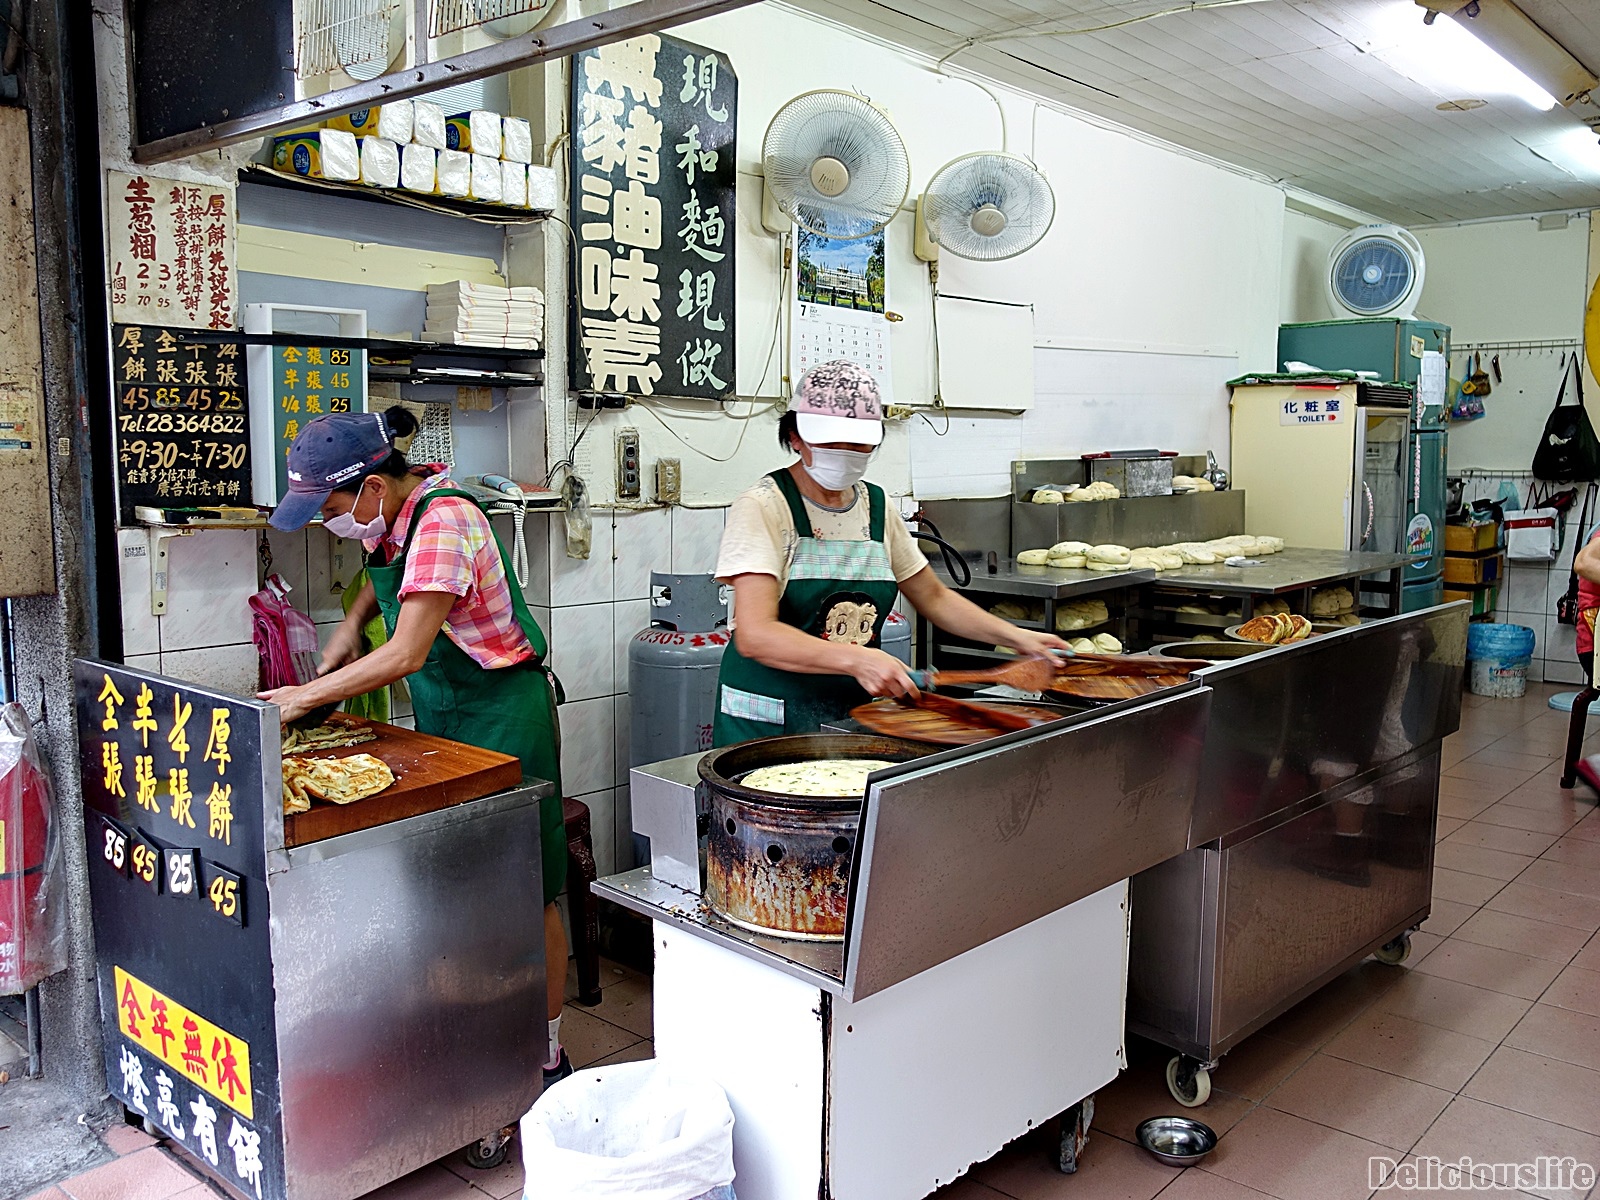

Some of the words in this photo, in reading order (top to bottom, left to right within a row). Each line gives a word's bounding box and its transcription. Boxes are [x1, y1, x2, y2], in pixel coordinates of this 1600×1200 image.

[675, 53, 729, 391] 現和麵現做
[113, 293, 127, 304] 35
[137, 295, 150, 306] 70
[158, 297, 170, 308] 95
[801, 304, 807, 317] 7
[118, 327, 147, 382] 厚餅
[156, 329, 182, 383] 全張
[330, 350, 349, 365] 85
[330, 372, 350, 388] 45
[122, 387, 149, 411] 45
[155, 387, 181, 408] 85
[186, 388, 212, 411] 45
[218, 390, 243, 411] 25
[331, 397, 349, 413] 25
[1284, 400, 1340, 414] 化粧室
[1297, 414, 1326, 423] TOILET
[98, 673, 126, 798] 全張
[132, 682, 160, 813] 半張
[203, 707, 234, 846] 厚餅
[105, 829, 125, 869] 85
[133, 845, 157, 882] 45
[169, 854, 193, 894] 25
[210, 876, 237, 917] 45
[121, 978, 247, 1102] 全年無休
